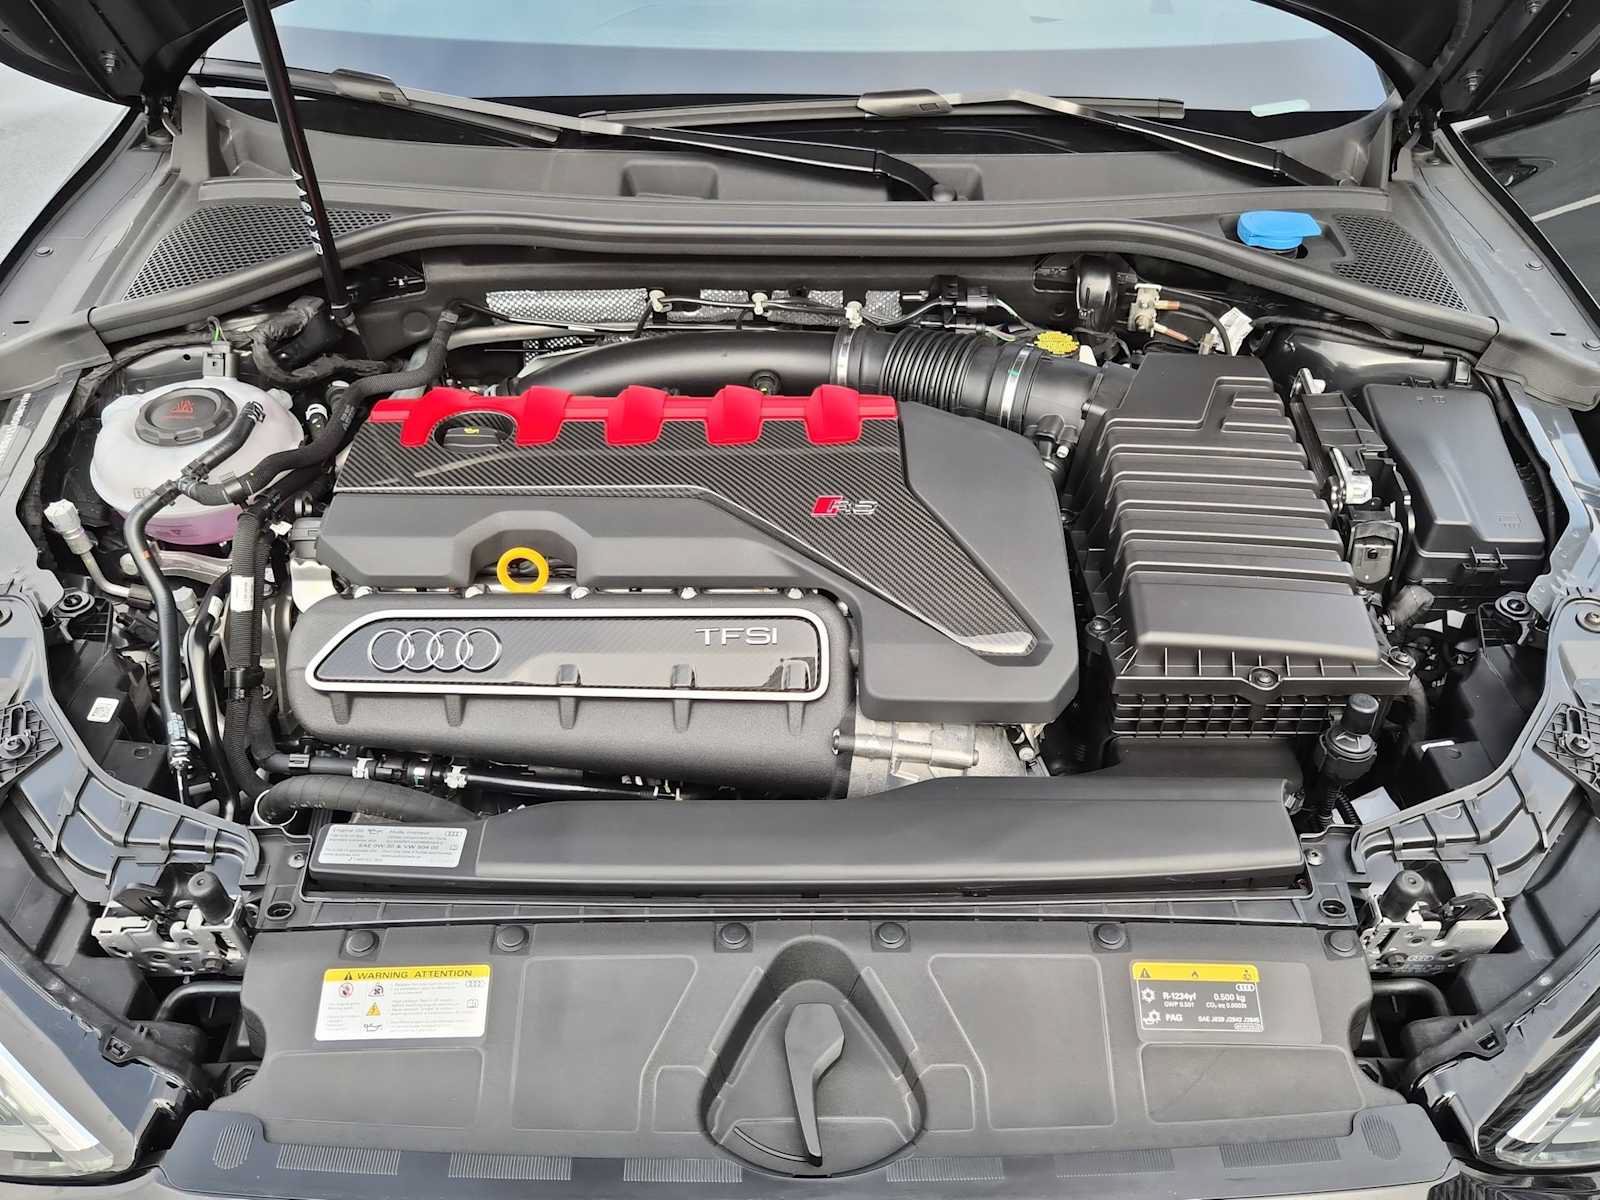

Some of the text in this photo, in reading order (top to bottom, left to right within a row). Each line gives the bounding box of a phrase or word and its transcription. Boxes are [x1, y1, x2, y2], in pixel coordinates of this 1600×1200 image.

[822, 498, 878, 516] RS
[695, 626, 778, 646] TFSI
[357, 970, 473, 979] WARNING ATTENTION
[1162, 992, 1246, 1002] R-1234yf 0.500 kg
[1165, 1014, 1183, 1022] PAG
